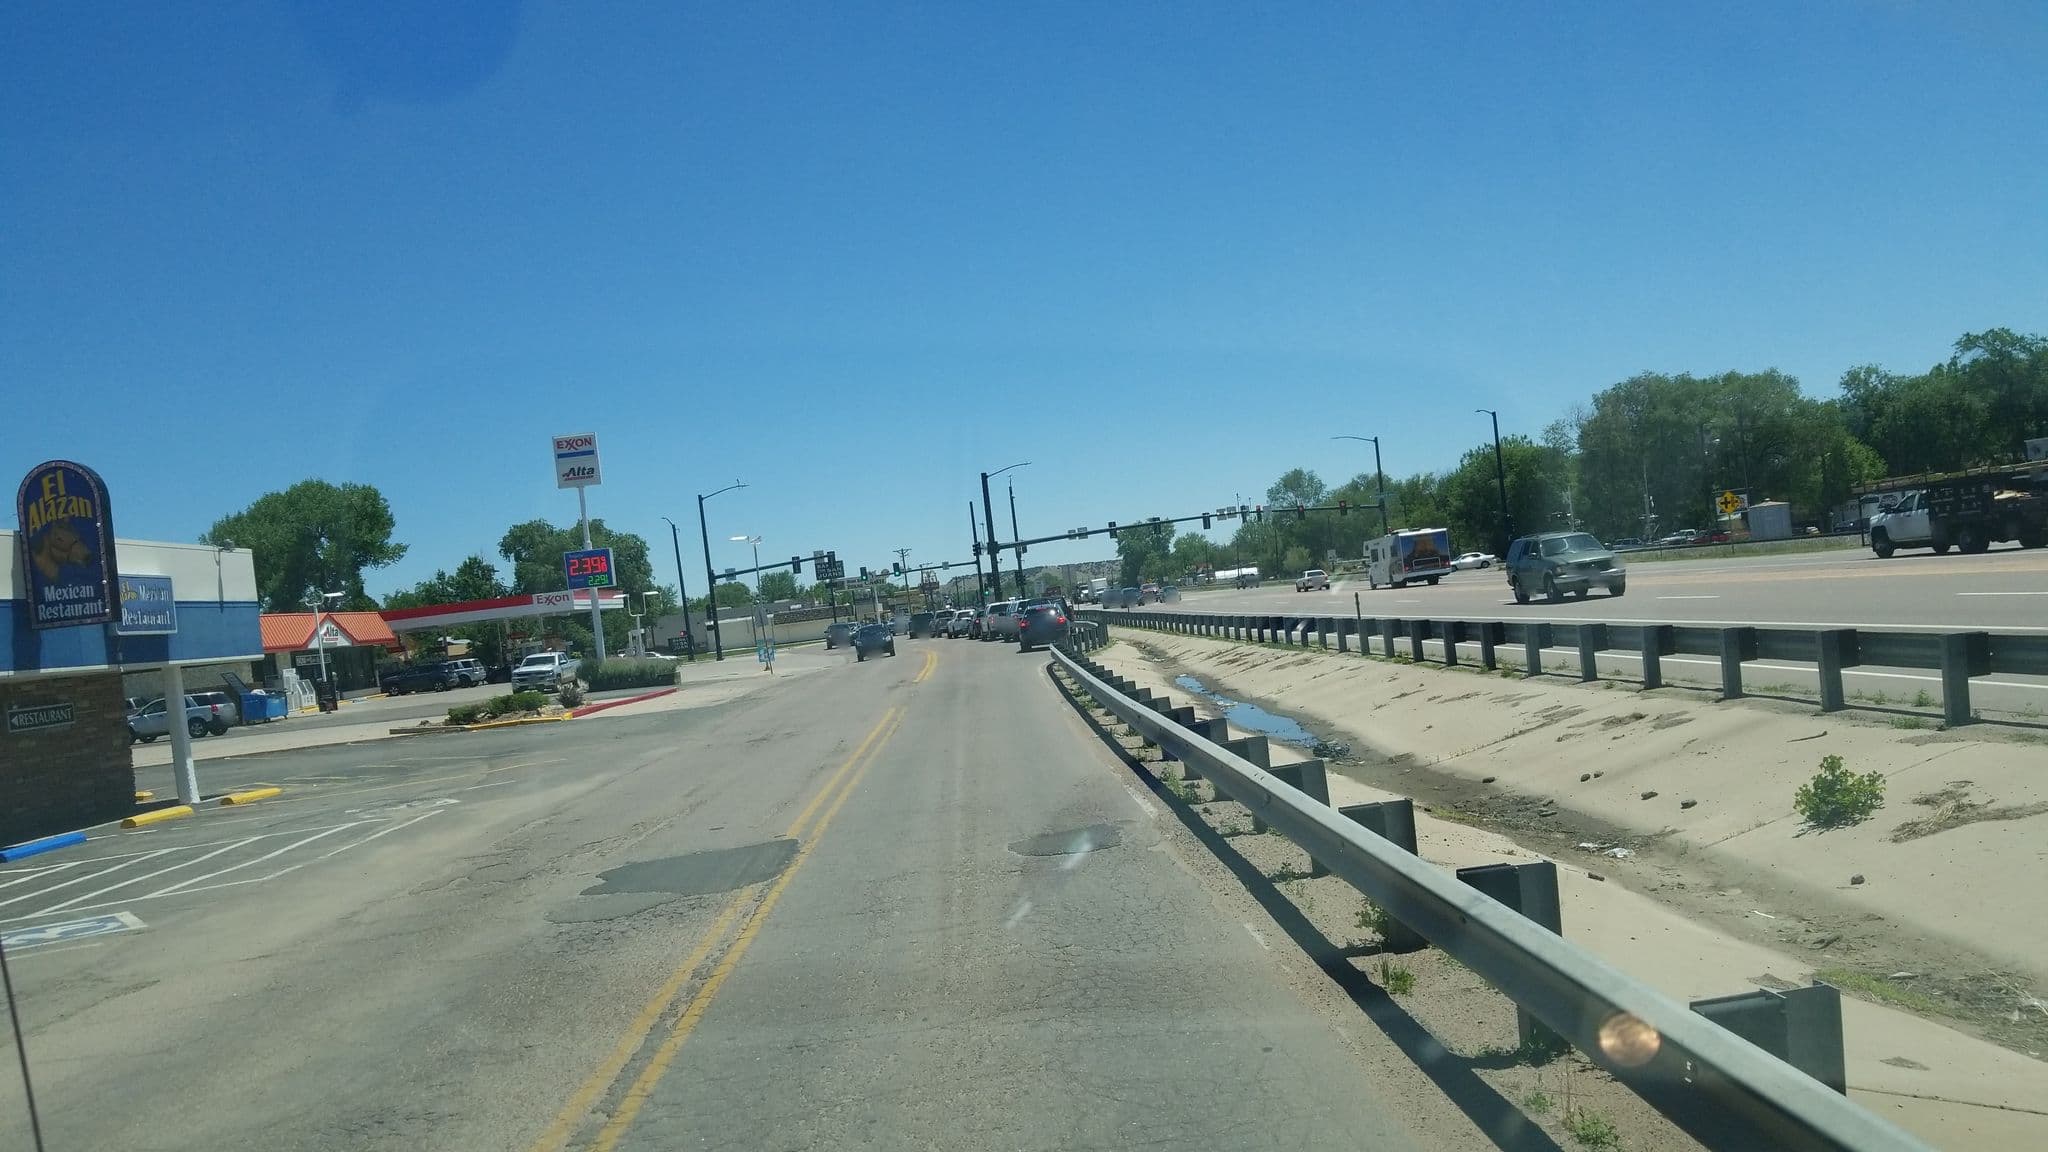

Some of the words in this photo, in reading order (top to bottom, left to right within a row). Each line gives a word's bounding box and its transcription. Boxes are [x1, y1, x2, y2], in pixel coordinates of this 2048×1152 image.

[556, 437, 592, 451] EXXON
[563, 466, 595, 478] Alta
[42, 469, 66, 500] El
[28, 495, 93, 537] Alazan
[44, 584, 94, 602] Mexican
[536, 594, 570, 606] Exxon
[38, 598, 103, 621] Restaurant
[121, 607, 171, 626] Restaurant
[18, 707, 72, 726] RESTAURANT
